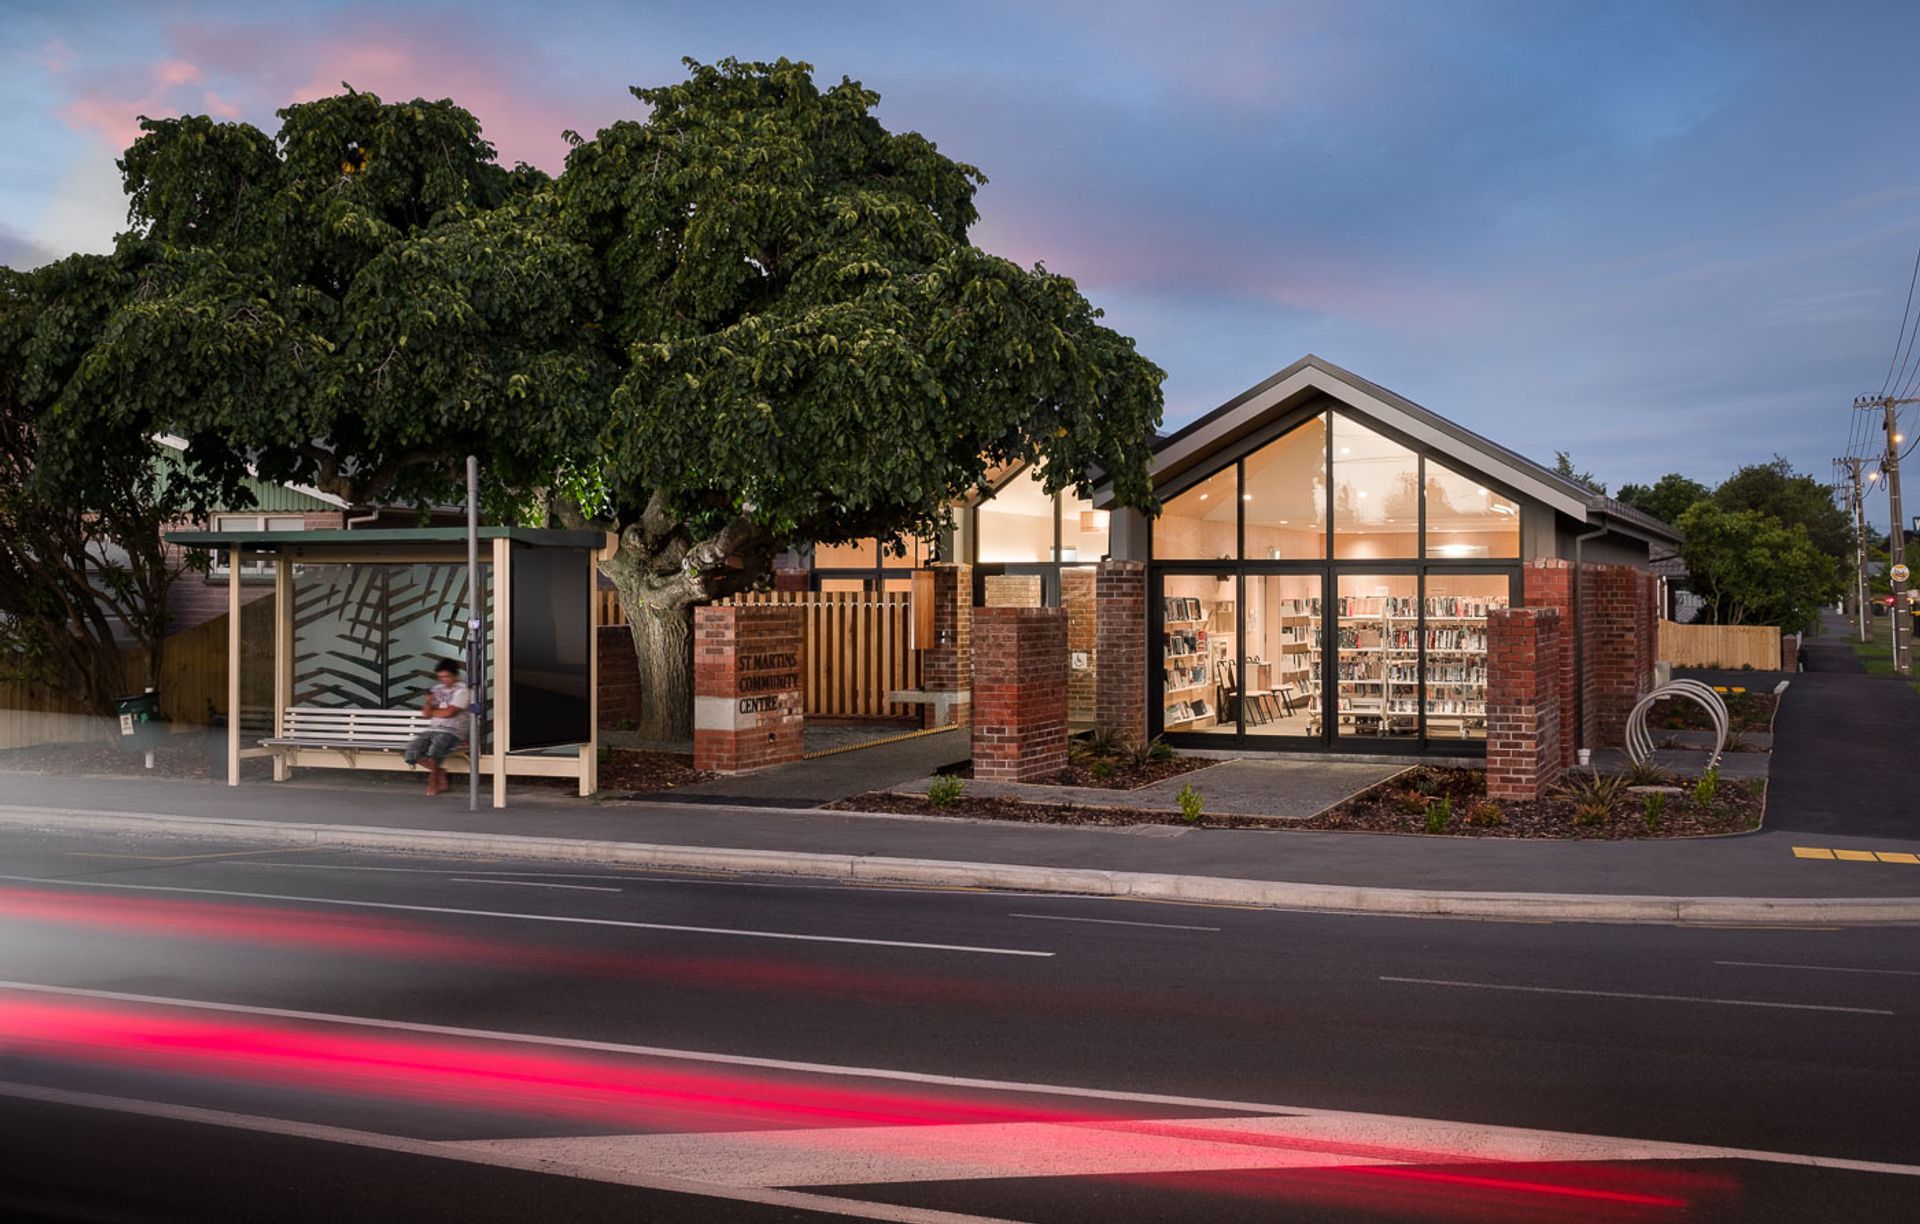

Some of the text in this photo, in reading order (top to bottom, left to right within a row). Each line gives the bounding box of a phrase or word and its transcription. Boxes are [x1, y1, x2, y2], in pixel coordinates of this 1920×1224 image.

[740, 653, 796, 671] ST MARTINS
[740, 674, 798, 692] COMMUNITY
[739, 696, 778, 714] CENTRE
